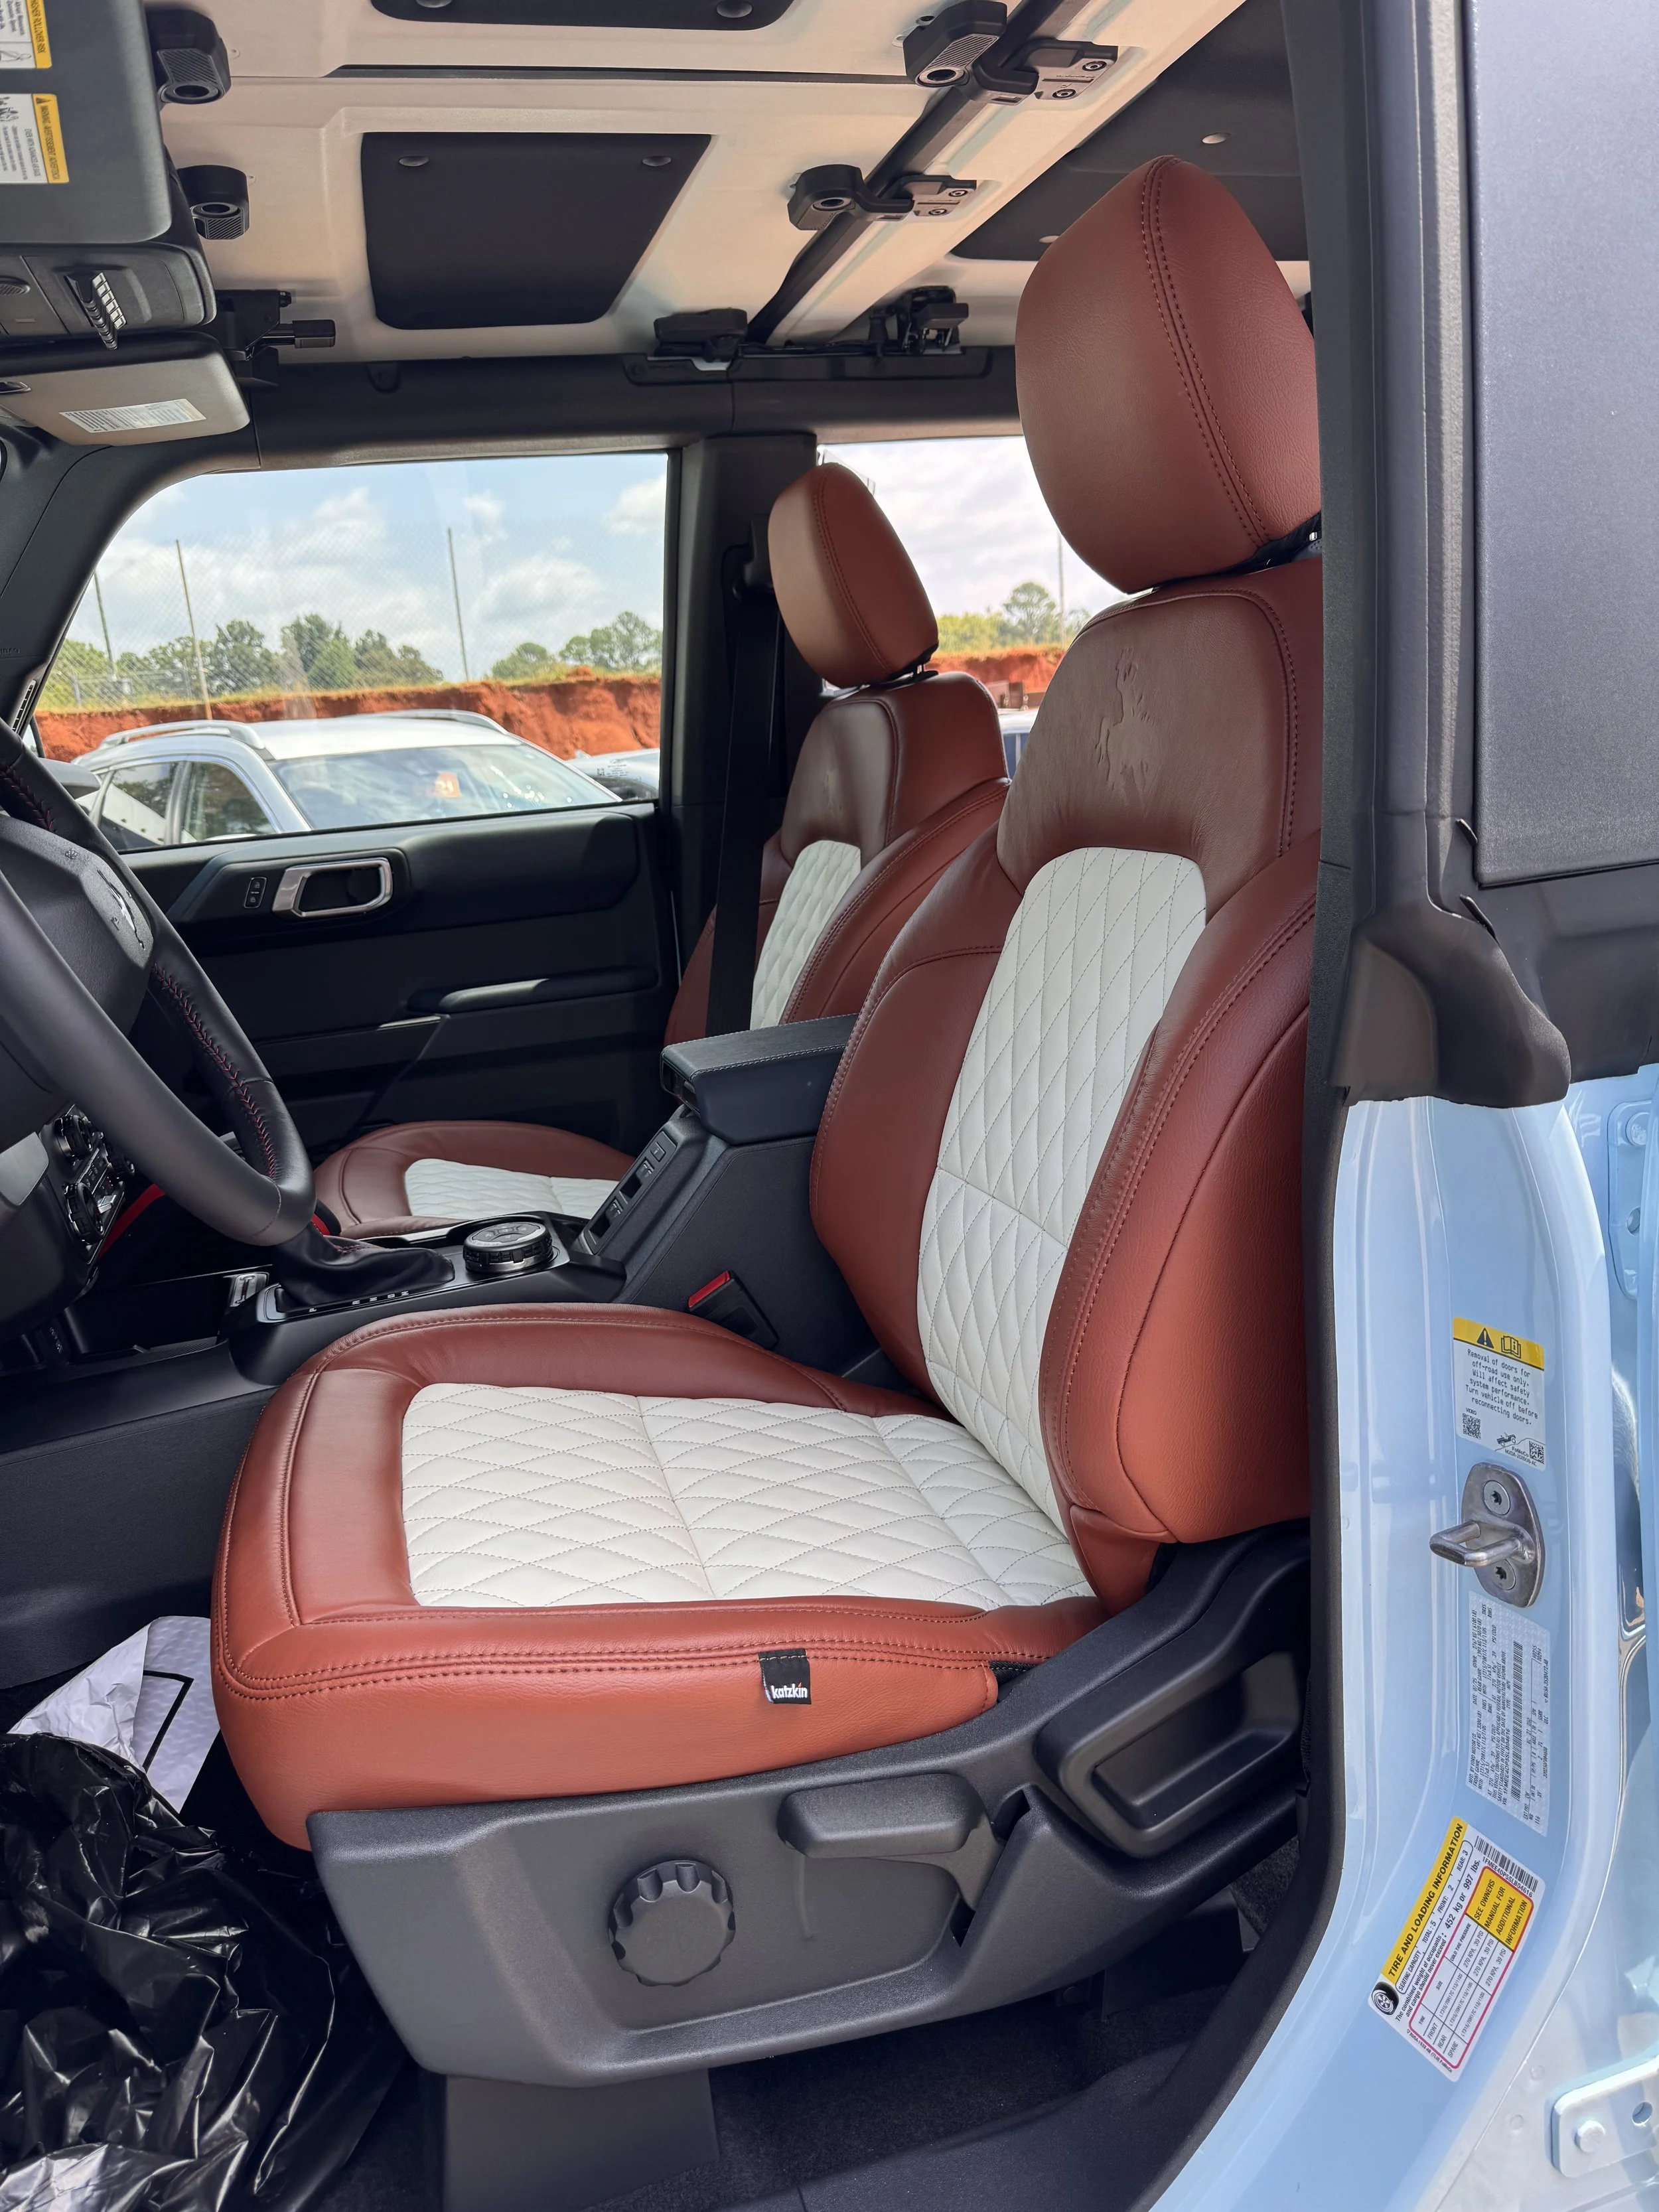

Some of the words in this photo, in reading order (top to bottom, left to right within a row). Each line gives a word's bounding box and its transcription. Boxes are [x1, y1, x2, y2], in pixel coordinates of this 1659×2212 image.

[1467, 1349, 1489, 1363] Removal
[1492, 1357, 1498, 1366] of
[1501, 1361, 1517, 1373] doors
[1521, 1368, 1530, 1378] for
[1472, 1359, 1497, 1375] off-road
[1500, 1371, 1510, 1380] use
[1513, 1374, 1528, 1388] only.
[1473, 1368, 1484, 1379] Will
[1488, 1374, 1507, 1388] affect
[1510, 1382, 1529, 1398] safety
[1465, 1384, 1478, 1396] Turn
[1480, 1390, 1503, 1405] vehicle
[1506, 1400, 1514, 1410] off
[1518, 1404, 1538, 1419] before
[1466, 1407, 1476, 1416] VIDEO
[1469, 1376, 1488, 1391] system
[1491, 1384, 1529, 1406] performance.
[1471, 1395, 1510, 1418] reconnecting
[1512, 1412, 1531, 1426] doors.
[771, 1682, 807, 1699] katzkin
[1444, 1912, 1455, 1930] 452
[1452, 1900, 1463, 1913] kg
[1459, 1891, 1466, 1902] or
[1463, 1873, 1474, 1890] 997
[1469, 1856, 1481, 1873] lbs.
[1482, 1855, 1534, 1898] 1FMEE4DP5SLB04616
[1388, 1953, 1404, 1978] TIRE
[1400, 1931, 1414, 1954] AND
[1410, 1888, 1435, 1933] LOADING
[1433, 1822, 1464, 1890] INFORMATION
[1473, 1905, 1484, 1921] SEE
[1479, 1878, 1496, 1907] OWNERS
[1484, 1899, 1500, 1929] MANUAL
[1495, 1885, 1506, 1901] FOR
[1494, 1895, 1516, 1935] ADDITIONAL
[1398, 1970, 1411, 1991] SEATING
[1407, 1949, 1421, 1973] CAPACITY
[1437, 1894, 1449, 1913] FRONT:
[1456, 1855, 1466, 1871] REAR:
[1459, 1922, 1471, 1943] PRESSURE
[1504, 1899, 1529, 1946] INFORMATION
[1395, 2010, 1404, 2023] The
[1400, 1984, 1416, 2012] combined
[1413, 1966, 1426, 1988] weight
[1425, 1933, 1443, 1963] occupants
[1410, 1990, 1421, 2008] cargo
[1417, 1971, 1429, 1991] should
[1427, 1957, 1437, 1974] never
[1433, 1937, 1447, 1958] exceed
[1427, 2022, 1438, 2040] FRONT
[1473, 1937, 1480, 1947] 39
[1437, 2033, 1447, 2049] REAR
[1483, 1946, 1490, 1954] 39
[1447, 2039, 1459, 2059] SPARE
[1495, 1956, 1502, 1964] 39
